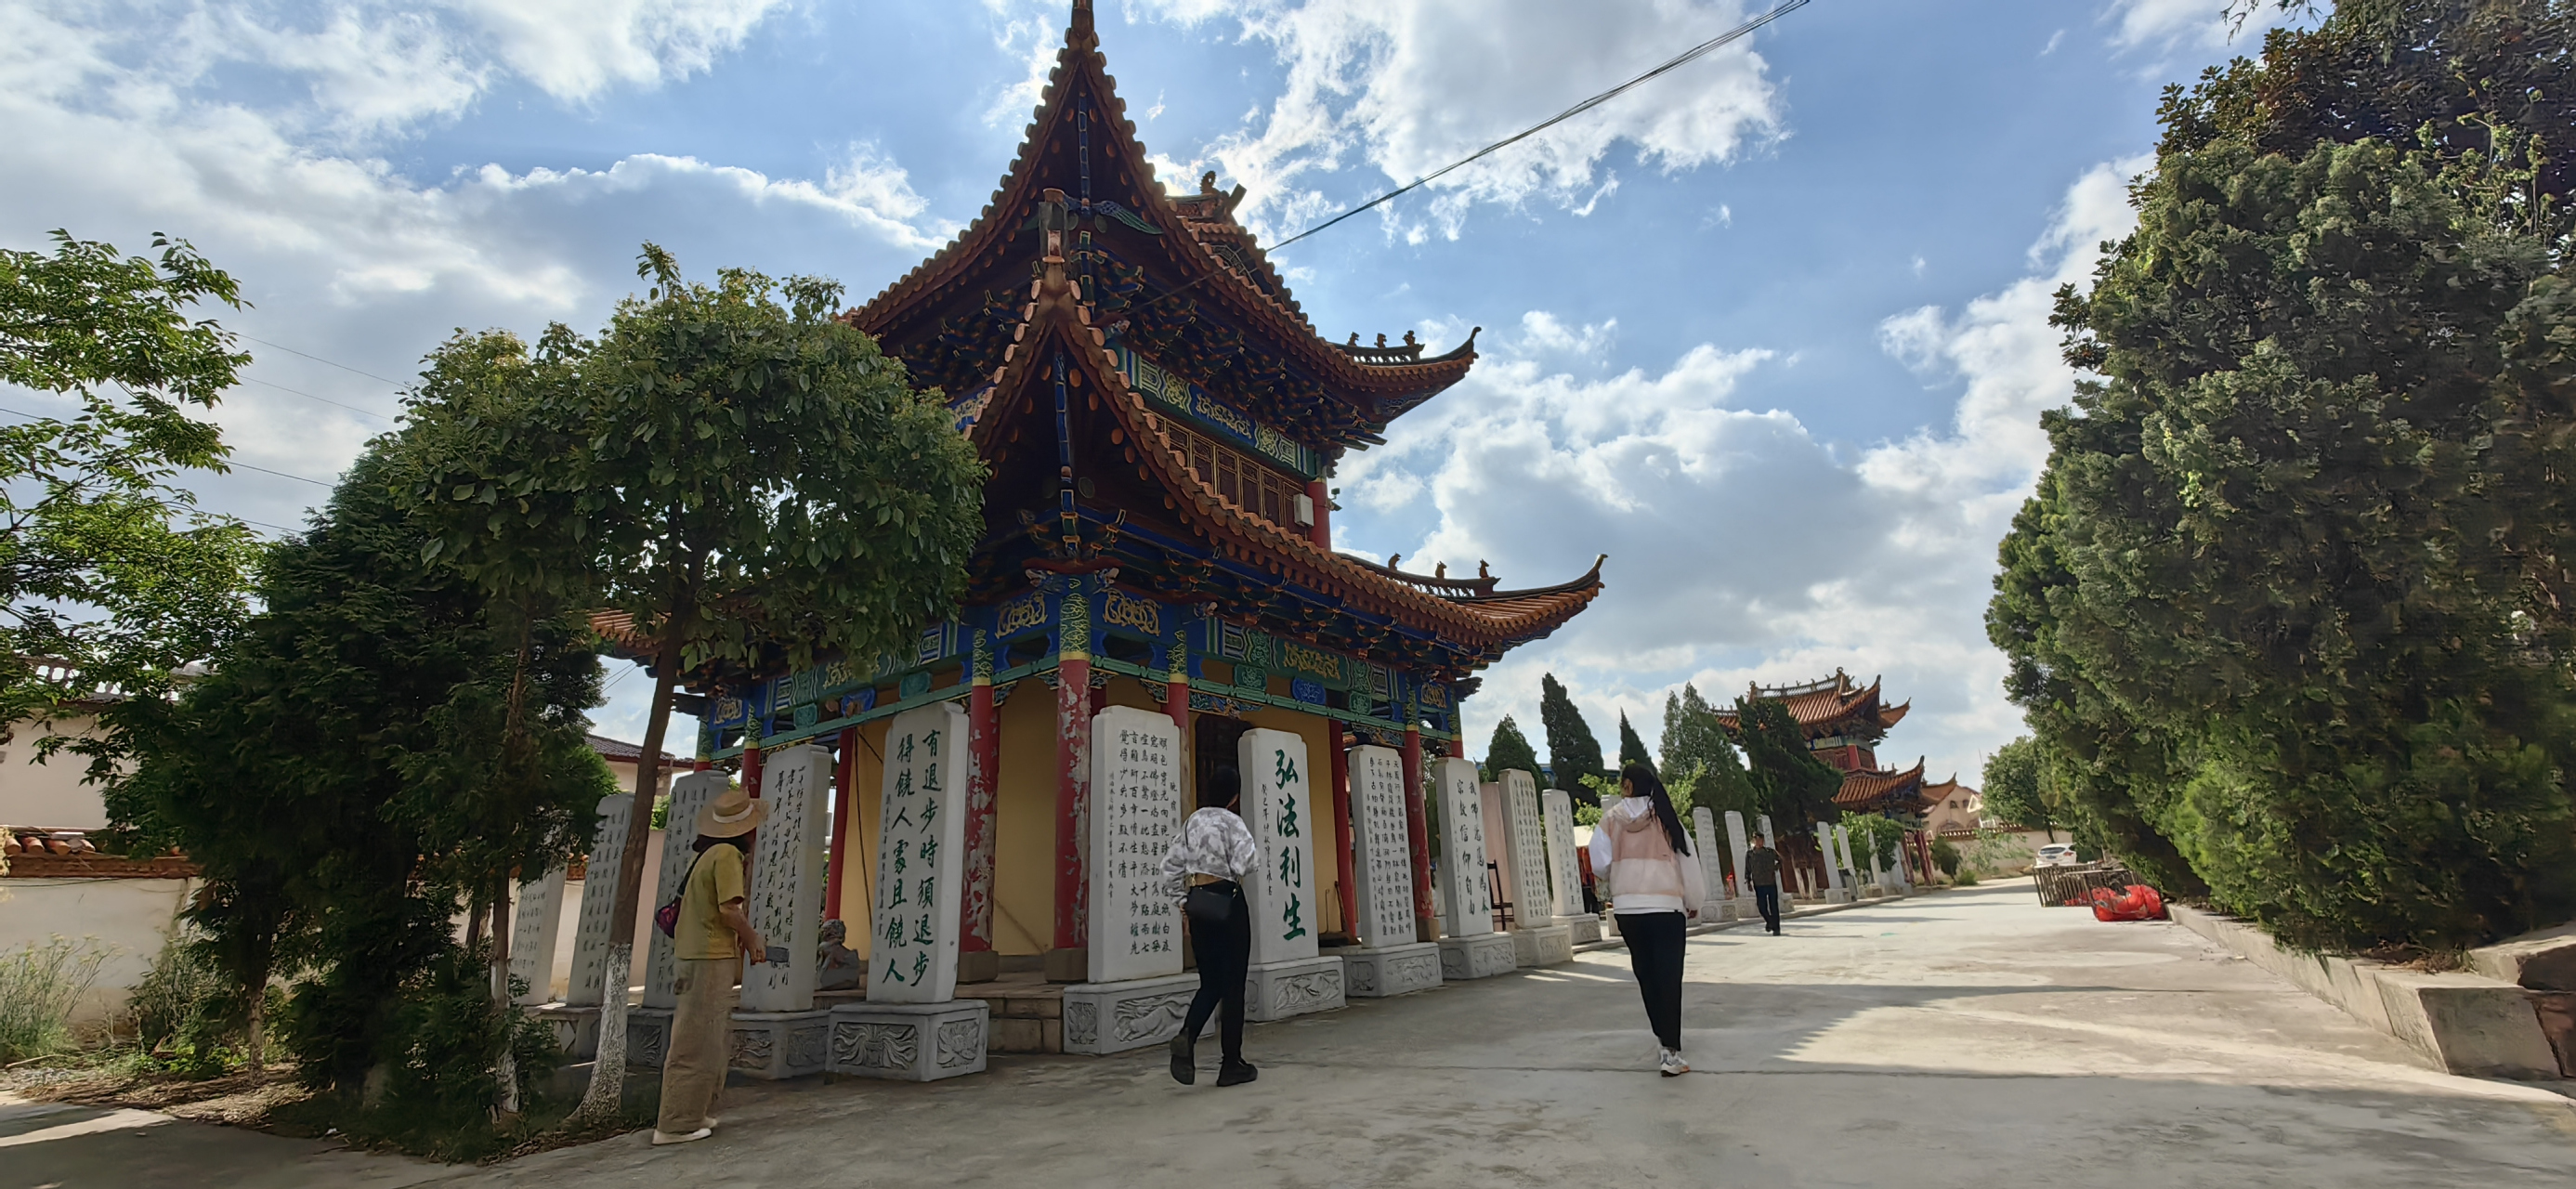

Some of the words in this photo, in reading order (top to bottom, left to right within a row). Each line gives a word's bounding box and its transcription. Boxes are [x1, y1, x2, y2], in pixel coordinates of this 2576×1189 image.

[909, 729, 941, 987] 有退步時須退步
[1275, 749, 1306, 941] 弘法利生
[1457, 778, 1475, 916] 宗教信仰自由
